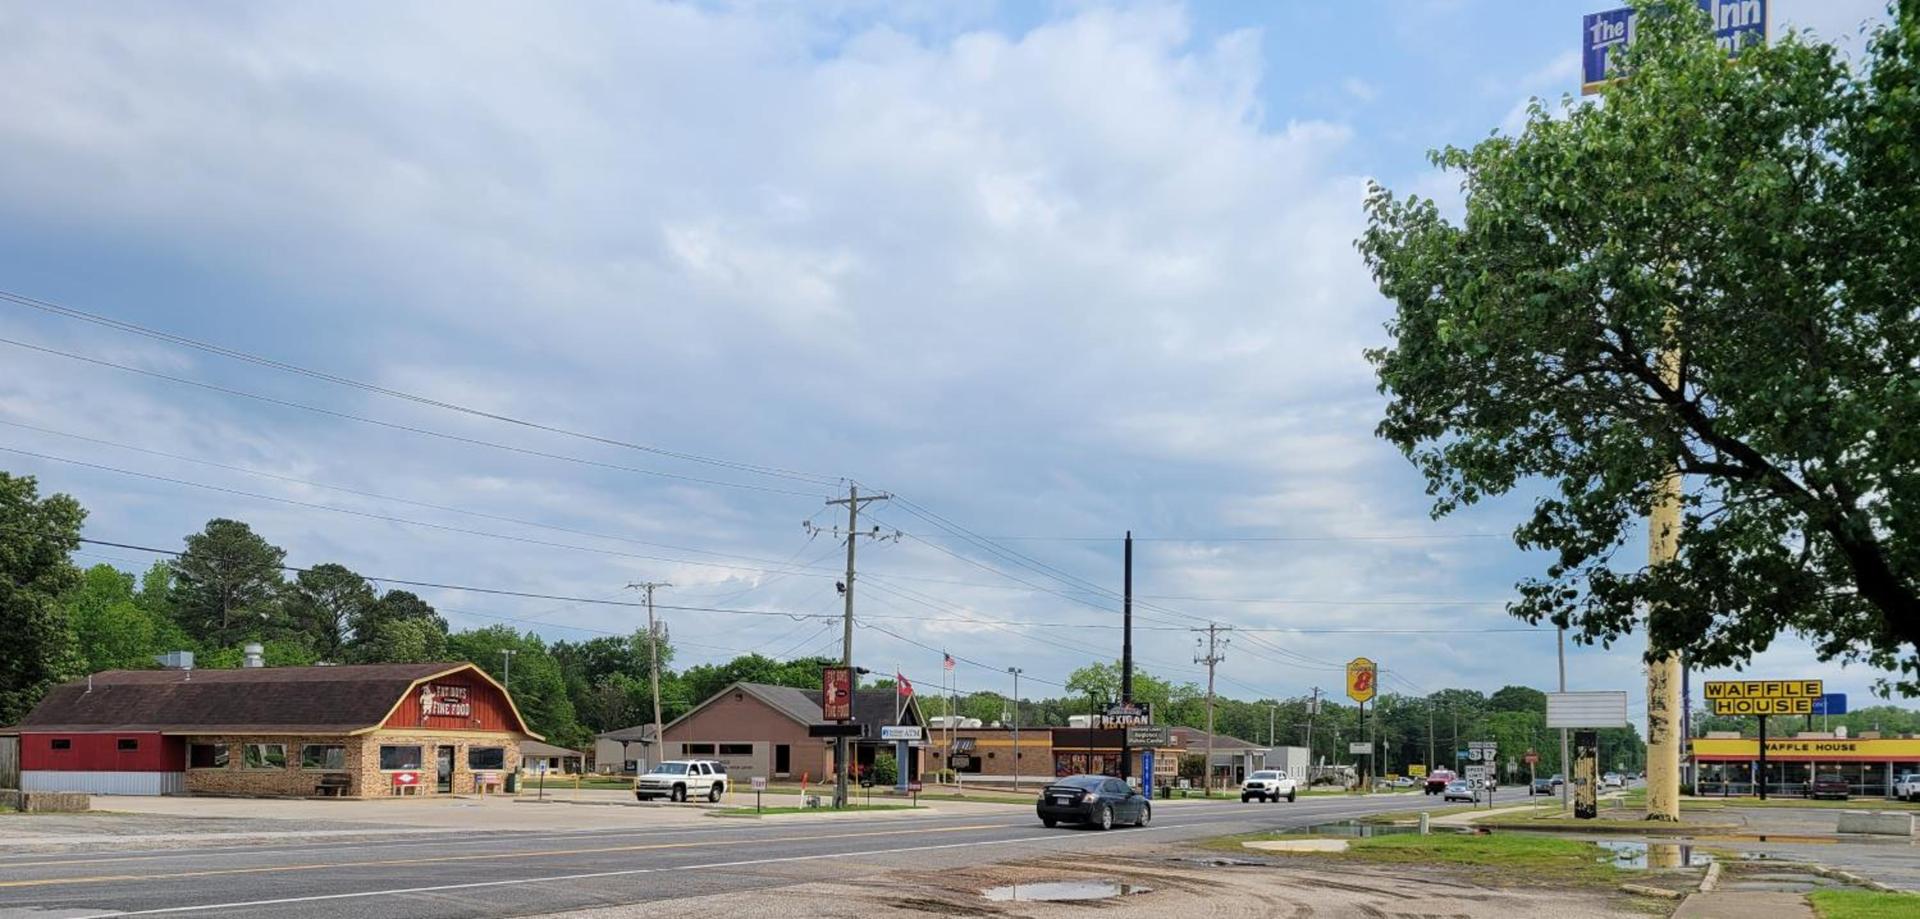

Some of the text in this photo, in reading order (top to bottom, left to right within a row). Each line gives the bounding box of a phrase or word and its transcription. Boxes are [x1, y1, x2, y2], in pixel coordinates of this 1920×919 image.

[1590, 15, 1624, 43] the
[1710, 0, 1761, 31] Inn
[1353, 671, 1371, 691] 8
[436, 686, 449, 697] FAT
[1708, 683, 1819, 696] WAFFLE
[433, 702, 470, 716] FINE FOOD
[1717, 699, 1809, 712] HOUSE
[1102, 715, 1148, 725] MEXICAN
[1815, 743, 1857, 751] HOUSE
[1468, 779, 1484, 789] 35
